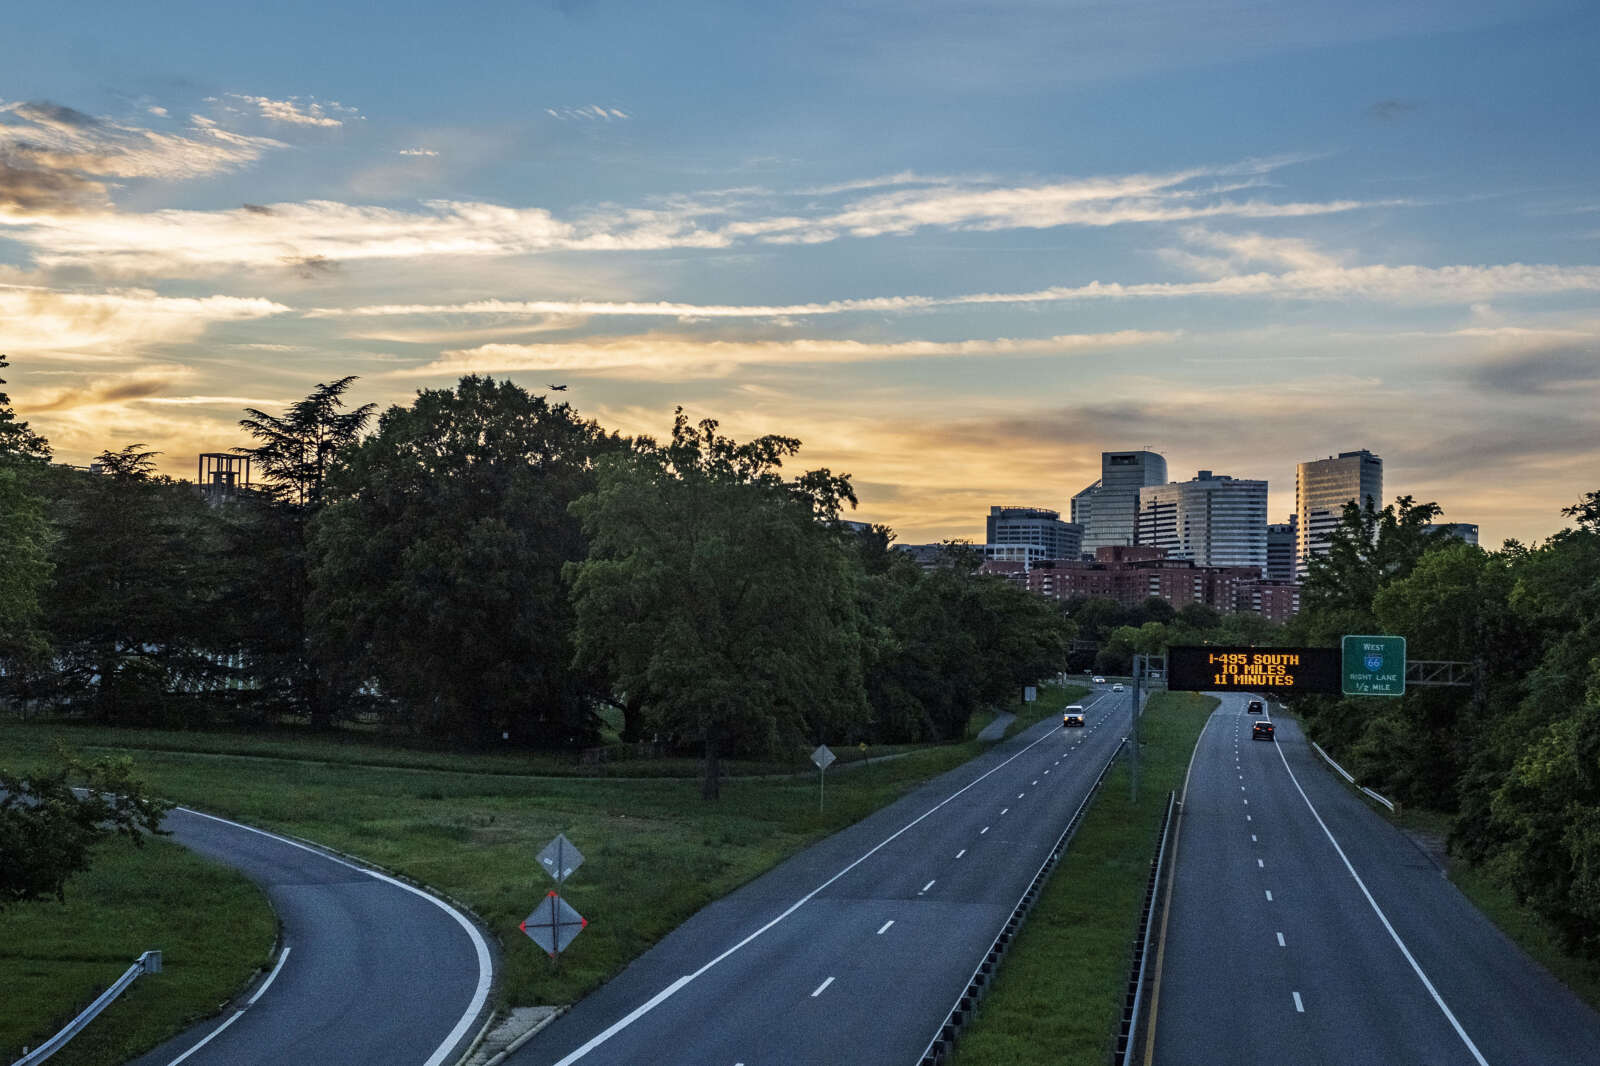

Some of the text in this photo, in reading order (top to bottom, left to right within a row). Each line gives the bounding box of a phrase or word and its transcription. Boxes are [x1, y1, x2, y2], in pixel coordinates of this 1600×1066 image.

[1209, 654, 1299, 665] I-495 SOUTH
[1367, 659, 1380, 667] 66
[1222, 664, 1286, 675] 10 MILES
[1214, 674, 1294, 685] 11 MINUTES
